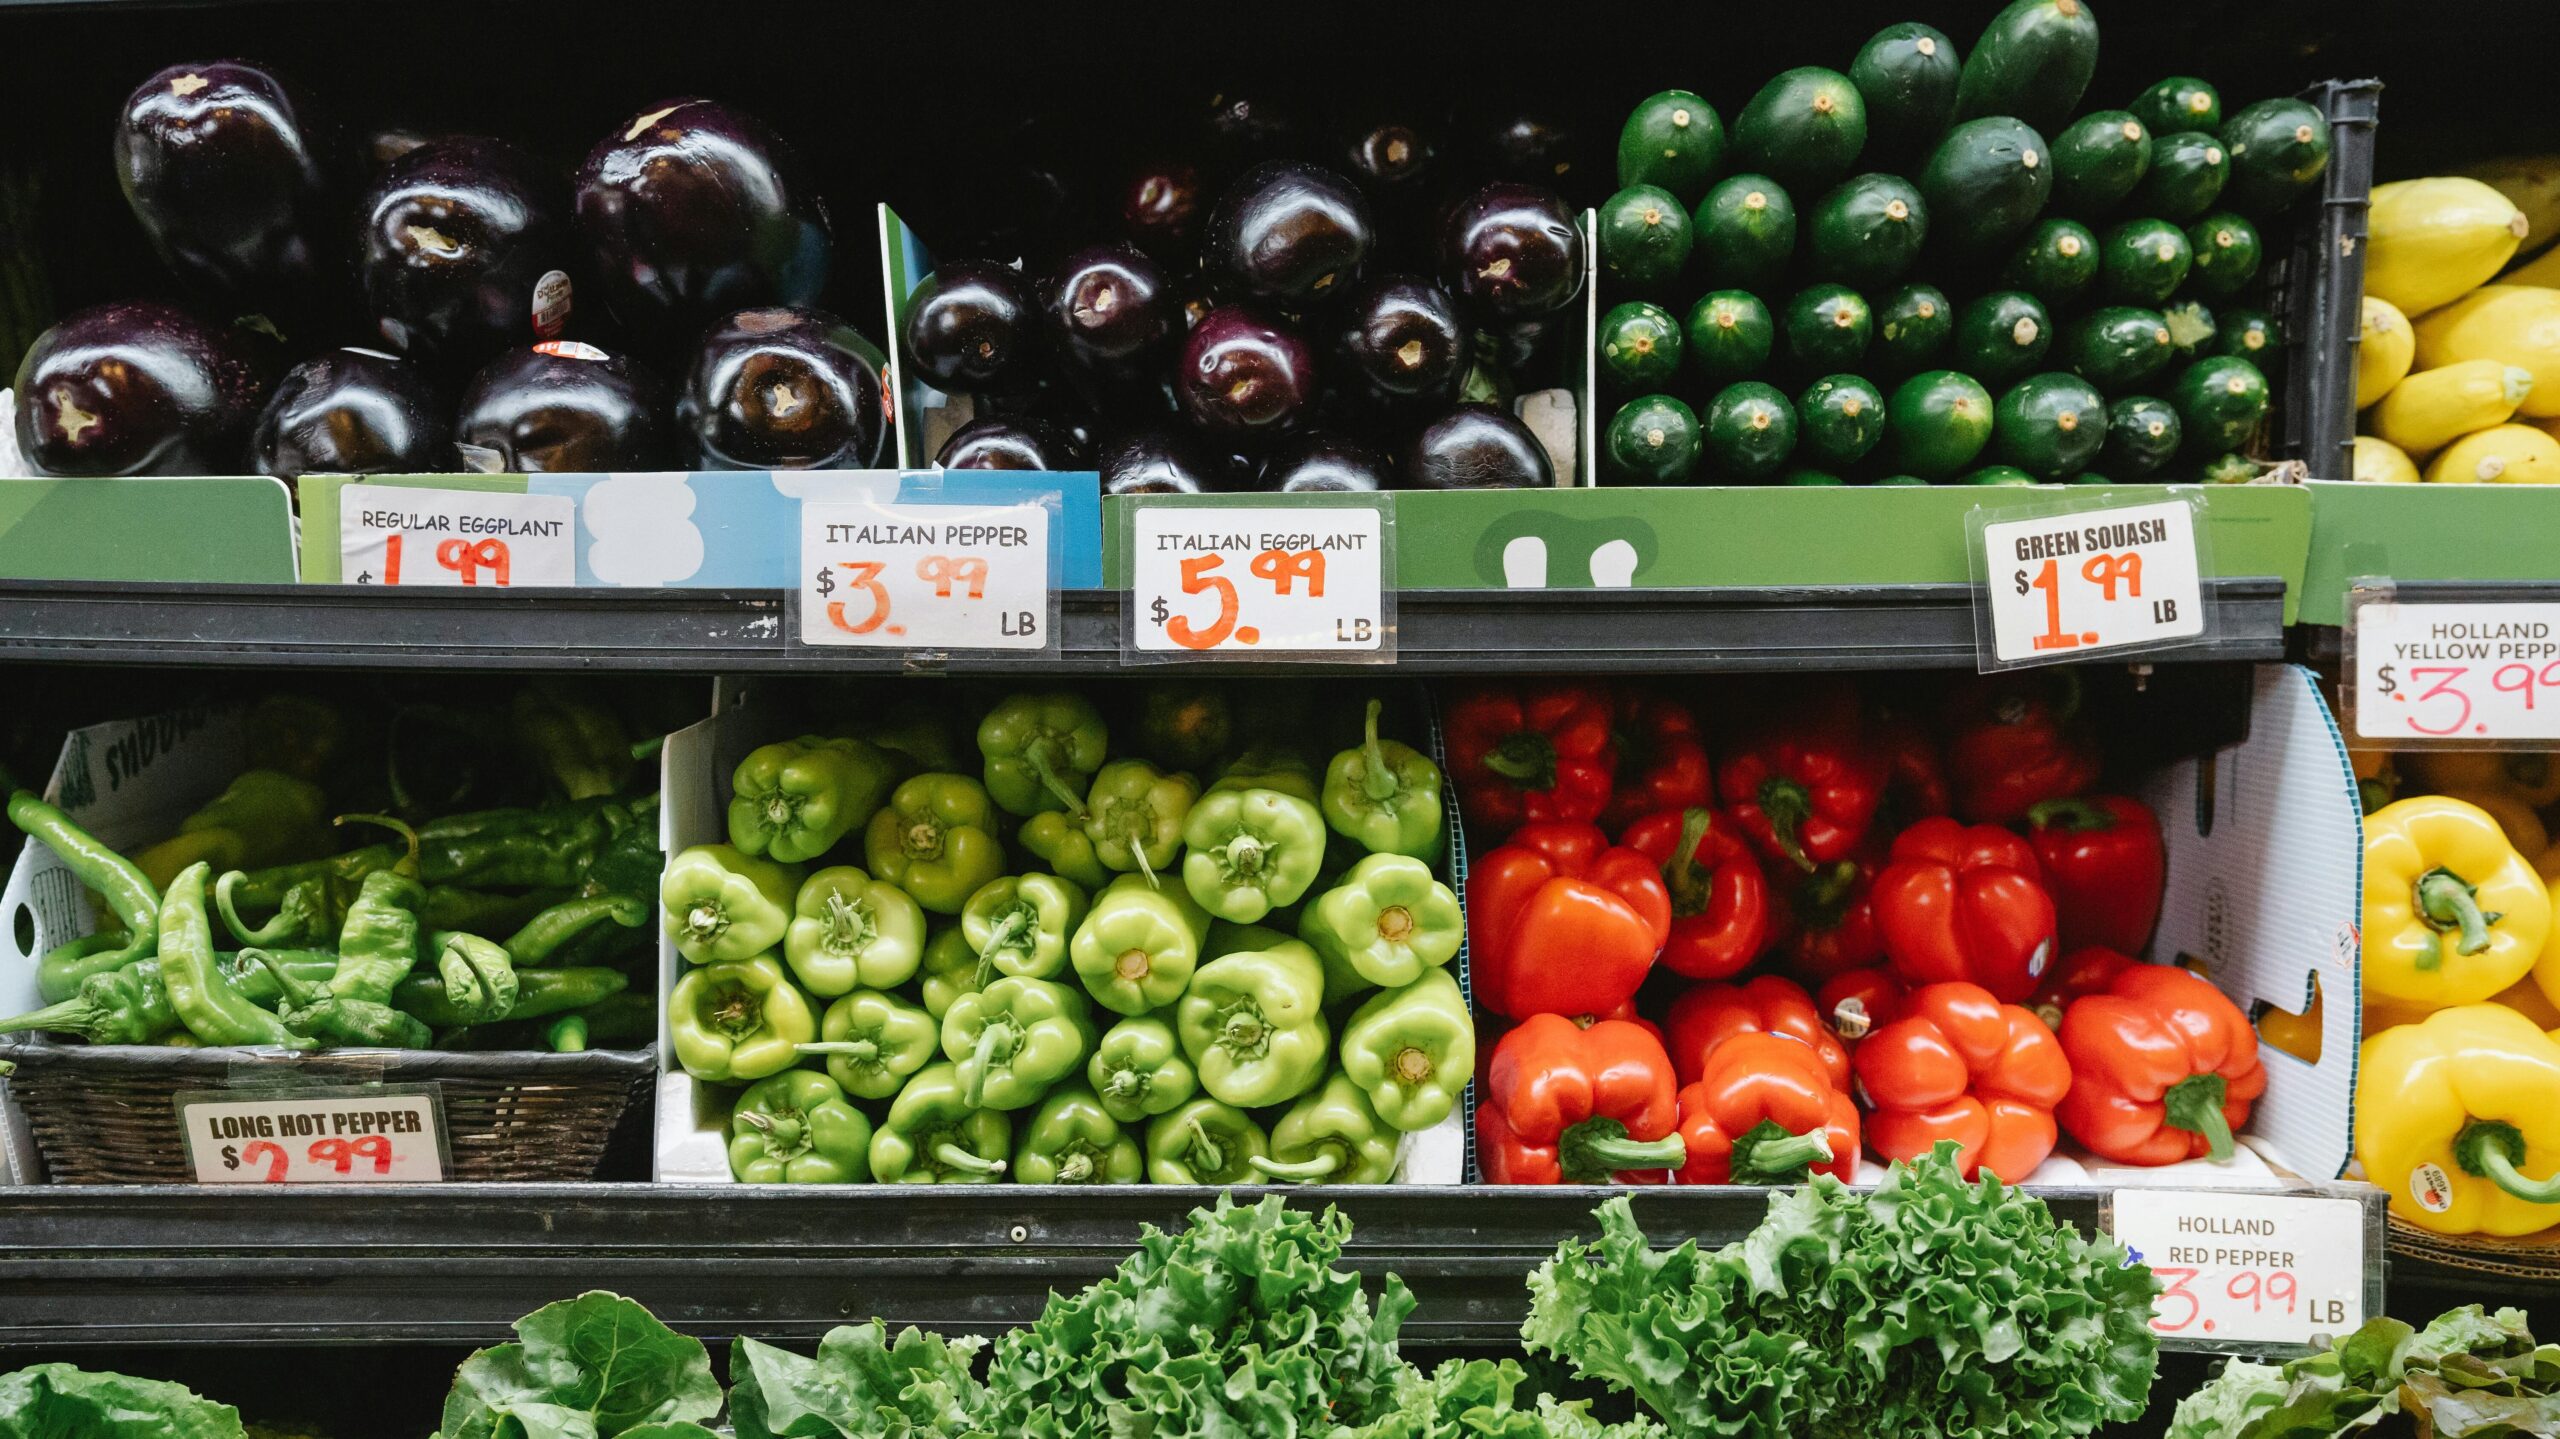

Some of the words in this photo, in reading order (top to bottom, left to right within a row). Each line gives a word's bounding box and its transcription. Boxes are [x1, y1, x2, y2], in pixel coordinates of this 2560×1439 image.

[362, 510, 450, 531] REGULAR
[459, 515, 563, 537] EGGPLANT
[825, 524, 936, 545] ITALIAN
[945, 525, 1028, 547] PEPPER
[1156, 533, 1251, 551] ITALIAN
[1260, 533, 1367, 551] EGGPLANT
[2015, 530, 2080, 561] GREEN
[2084, 518, 2167, 552] SQUASH
[2153, 599, 2178, 624] LB
[1001, 611, 1036, 637] LB
[1336, 618, 1373, 642] LB
[2432, 623, 2549, 639] HOLLAND
[2394, 643, 2490, 660] YELLOW
[2499, 643, 2560, 660] PEPP
[209, 1115, 274, 1140] LONG
[277, 1113, 327, 1137] HOT
[332, 1110, 422, 1135] PEPPER
[2178, 1216, 2275, 1236] HOLLAND
[2169, 1246, 2209, 1264] RED
[2216, 1248, 2295, 1268] PEPPER
[2309, 1298, 2345, 1324] LB
